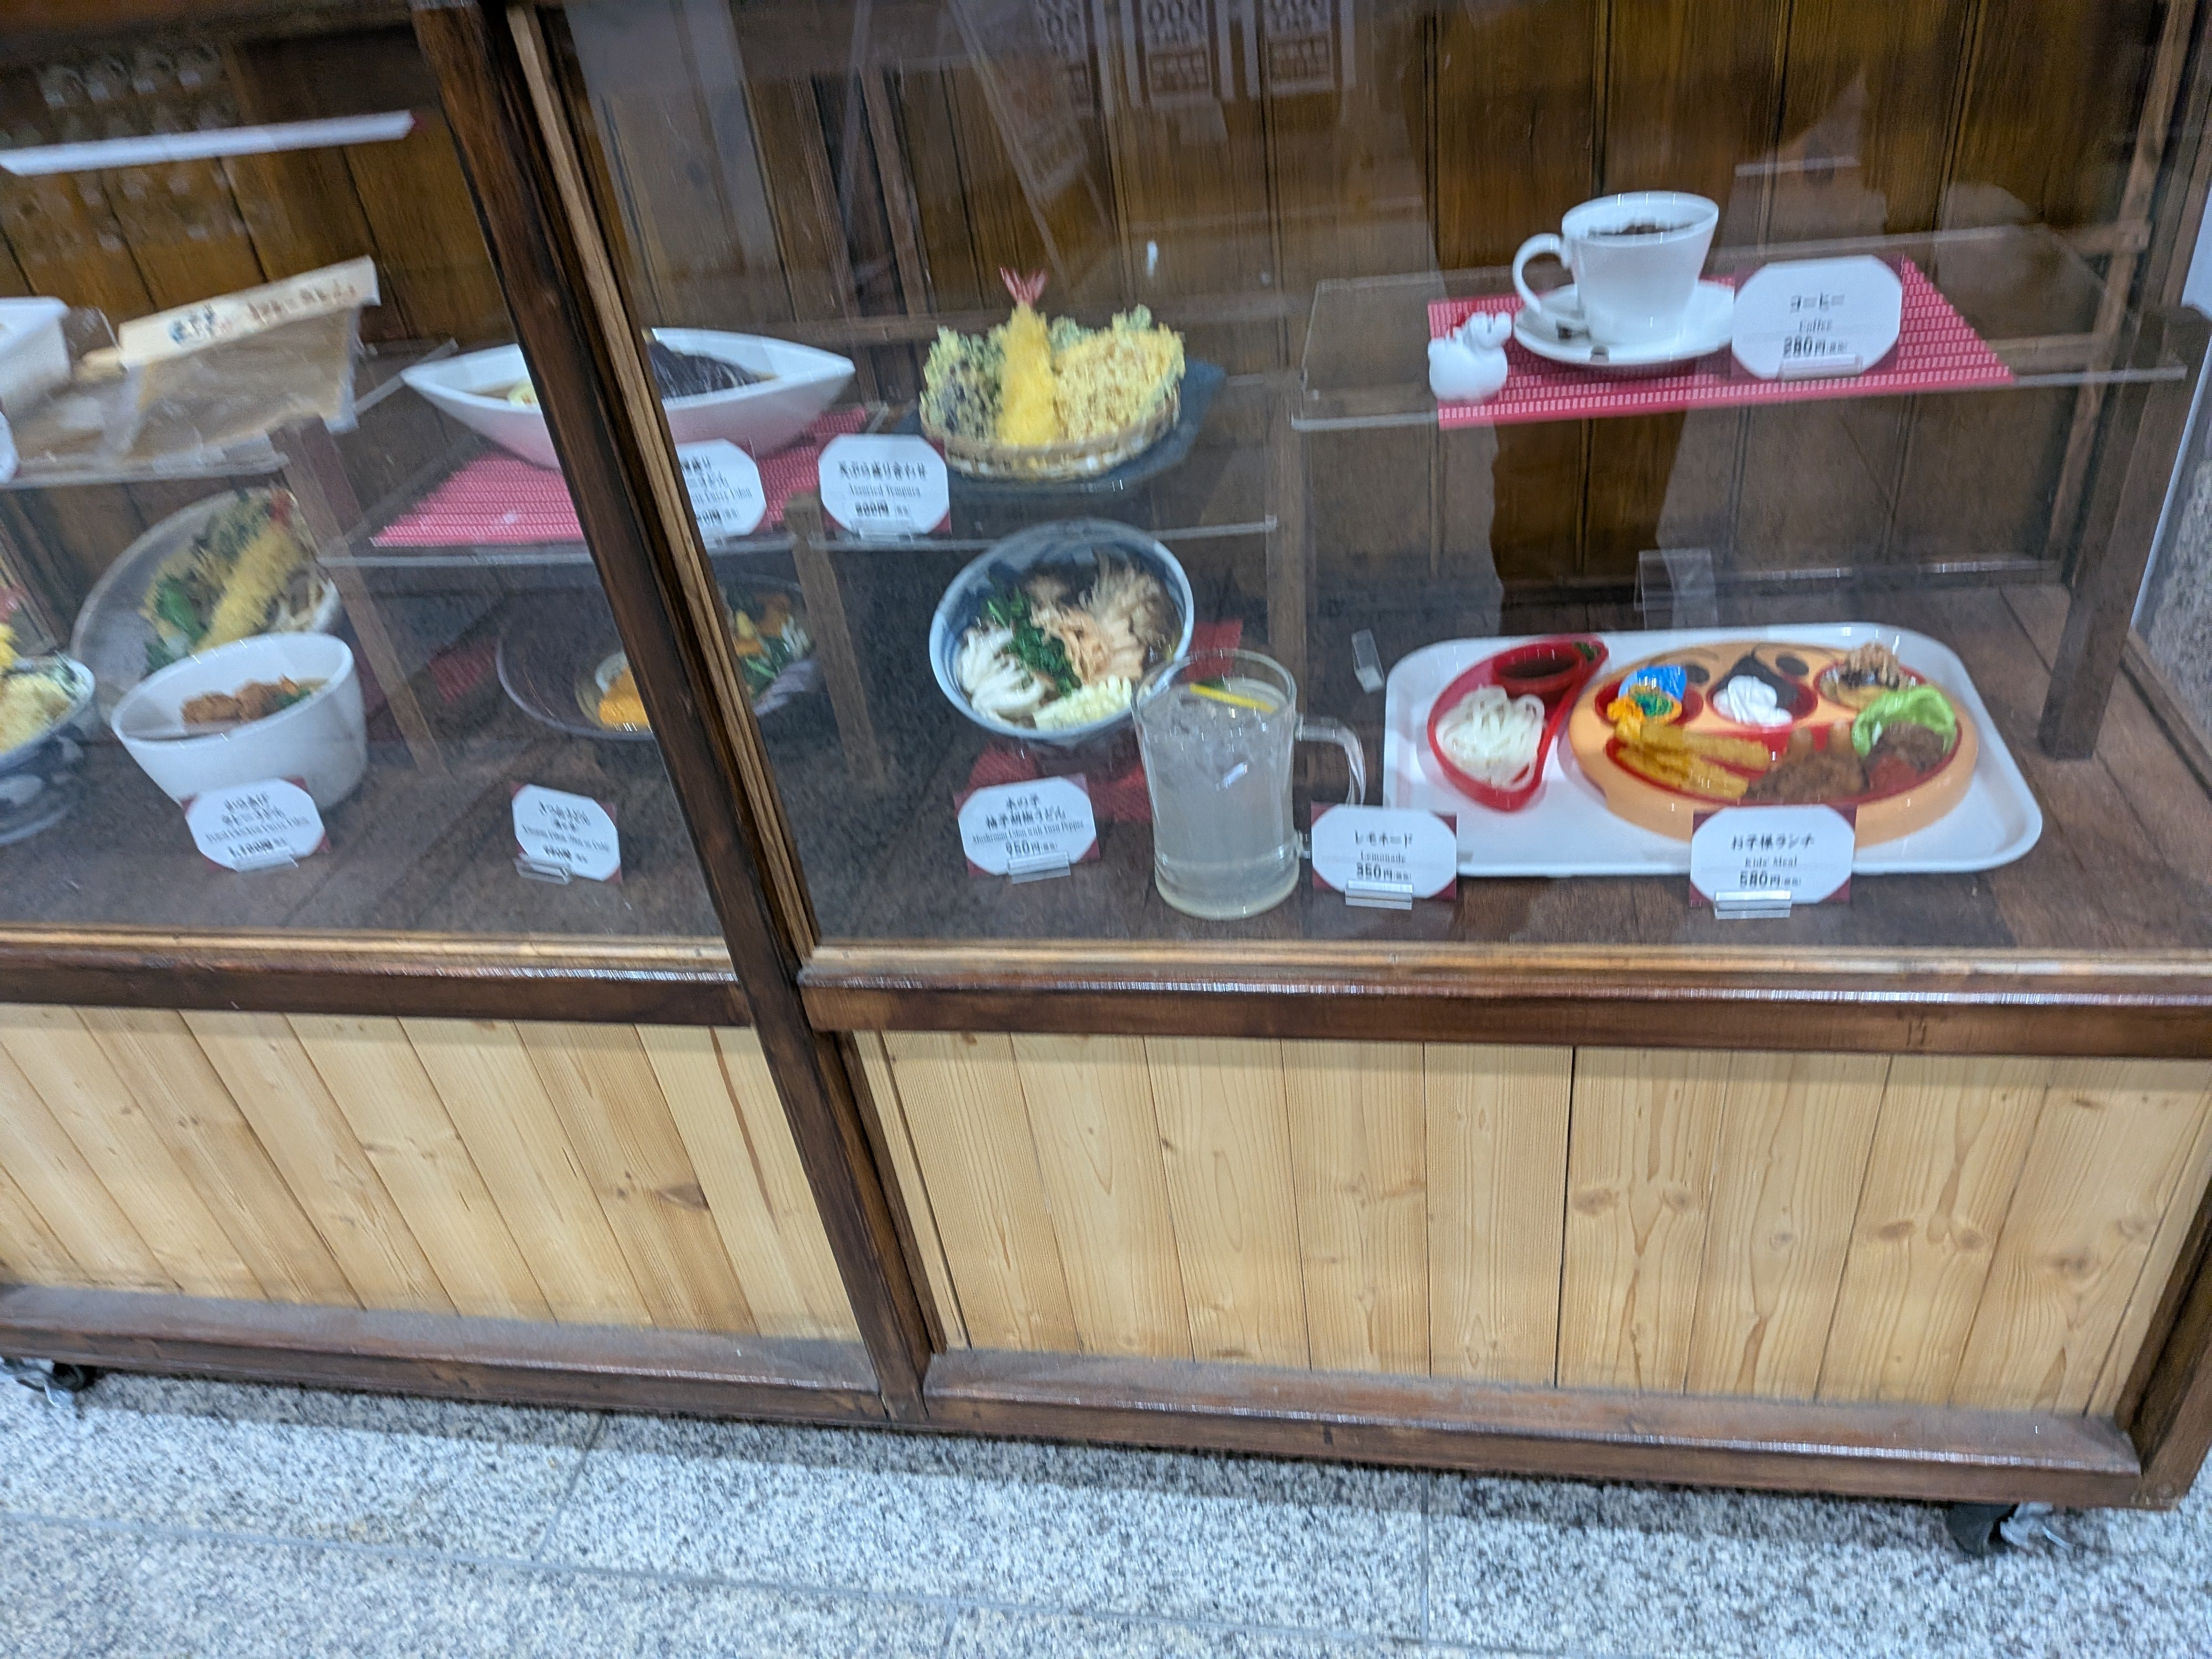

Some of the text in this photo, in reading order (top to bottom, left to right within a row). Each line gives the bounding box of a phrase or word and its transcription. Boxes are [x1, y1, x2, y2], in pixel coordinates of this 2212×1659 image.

[1790, 292, 1845, 313] コーヒー
[1355, 830, 1413, 849] レモネード
[1731, 832, 1815, 851] お子様ランチ
[1360, 849, 1406, 864] Lemonade
